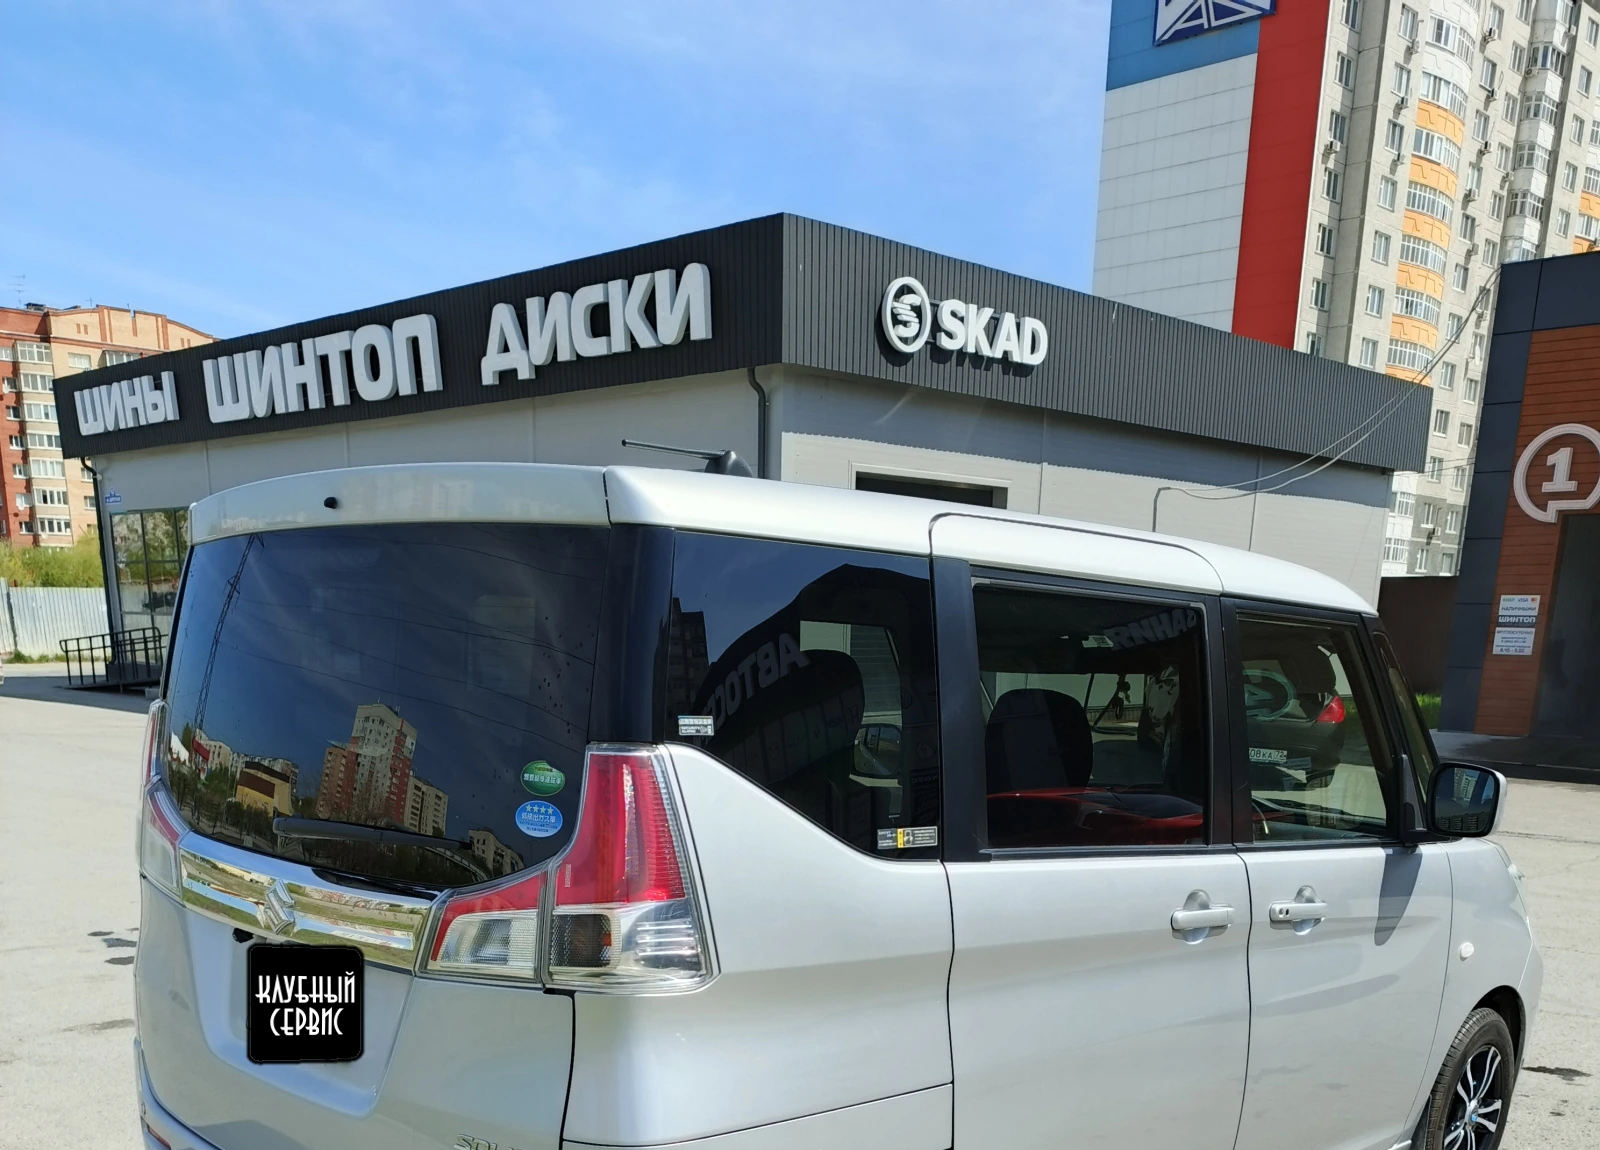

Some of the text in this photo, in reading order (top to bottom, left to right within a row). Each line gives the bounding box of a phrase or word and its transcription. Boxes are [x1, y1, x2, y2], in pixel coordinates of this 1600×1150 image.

[74, 262, 713, 436] ШИНЫ ШИНТОП ДИСКИ
[936, 299, 1049, 366] SKAD
[1541, 447, 1578, 493] 1
[1249, 748, 1273, 759] 08КА
